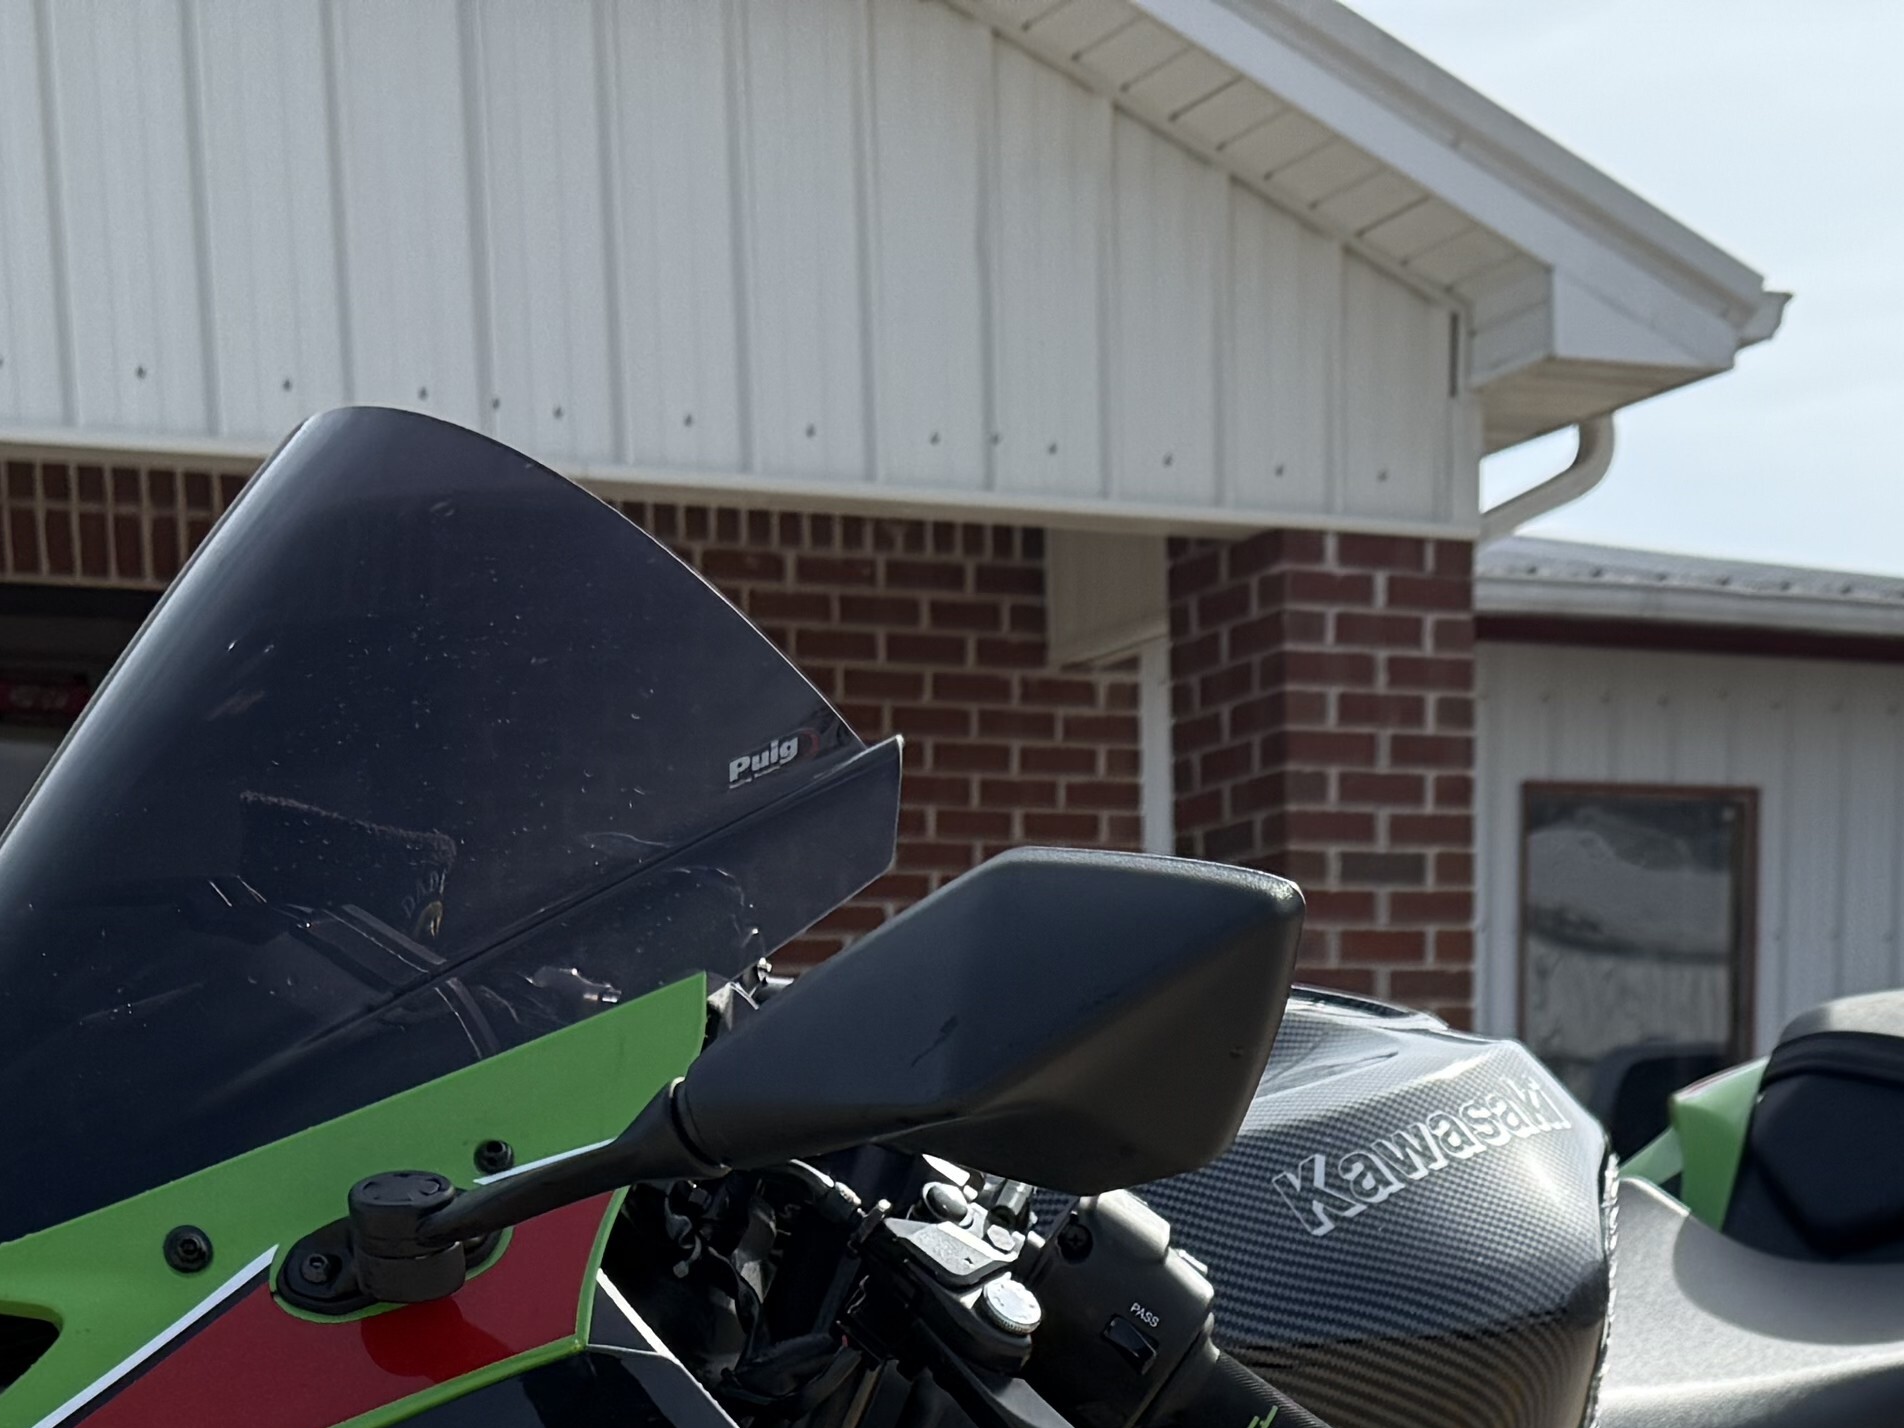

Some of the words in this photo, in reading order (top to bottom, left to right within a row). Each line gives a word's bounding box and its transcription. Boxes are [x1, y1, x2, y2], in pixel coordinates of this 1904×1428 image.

[729, 736, 799, 783] Puig
[1271, 1074, 1572, 1237] Kawasaki
[1130, 1302, 1160, 1328] PASS
